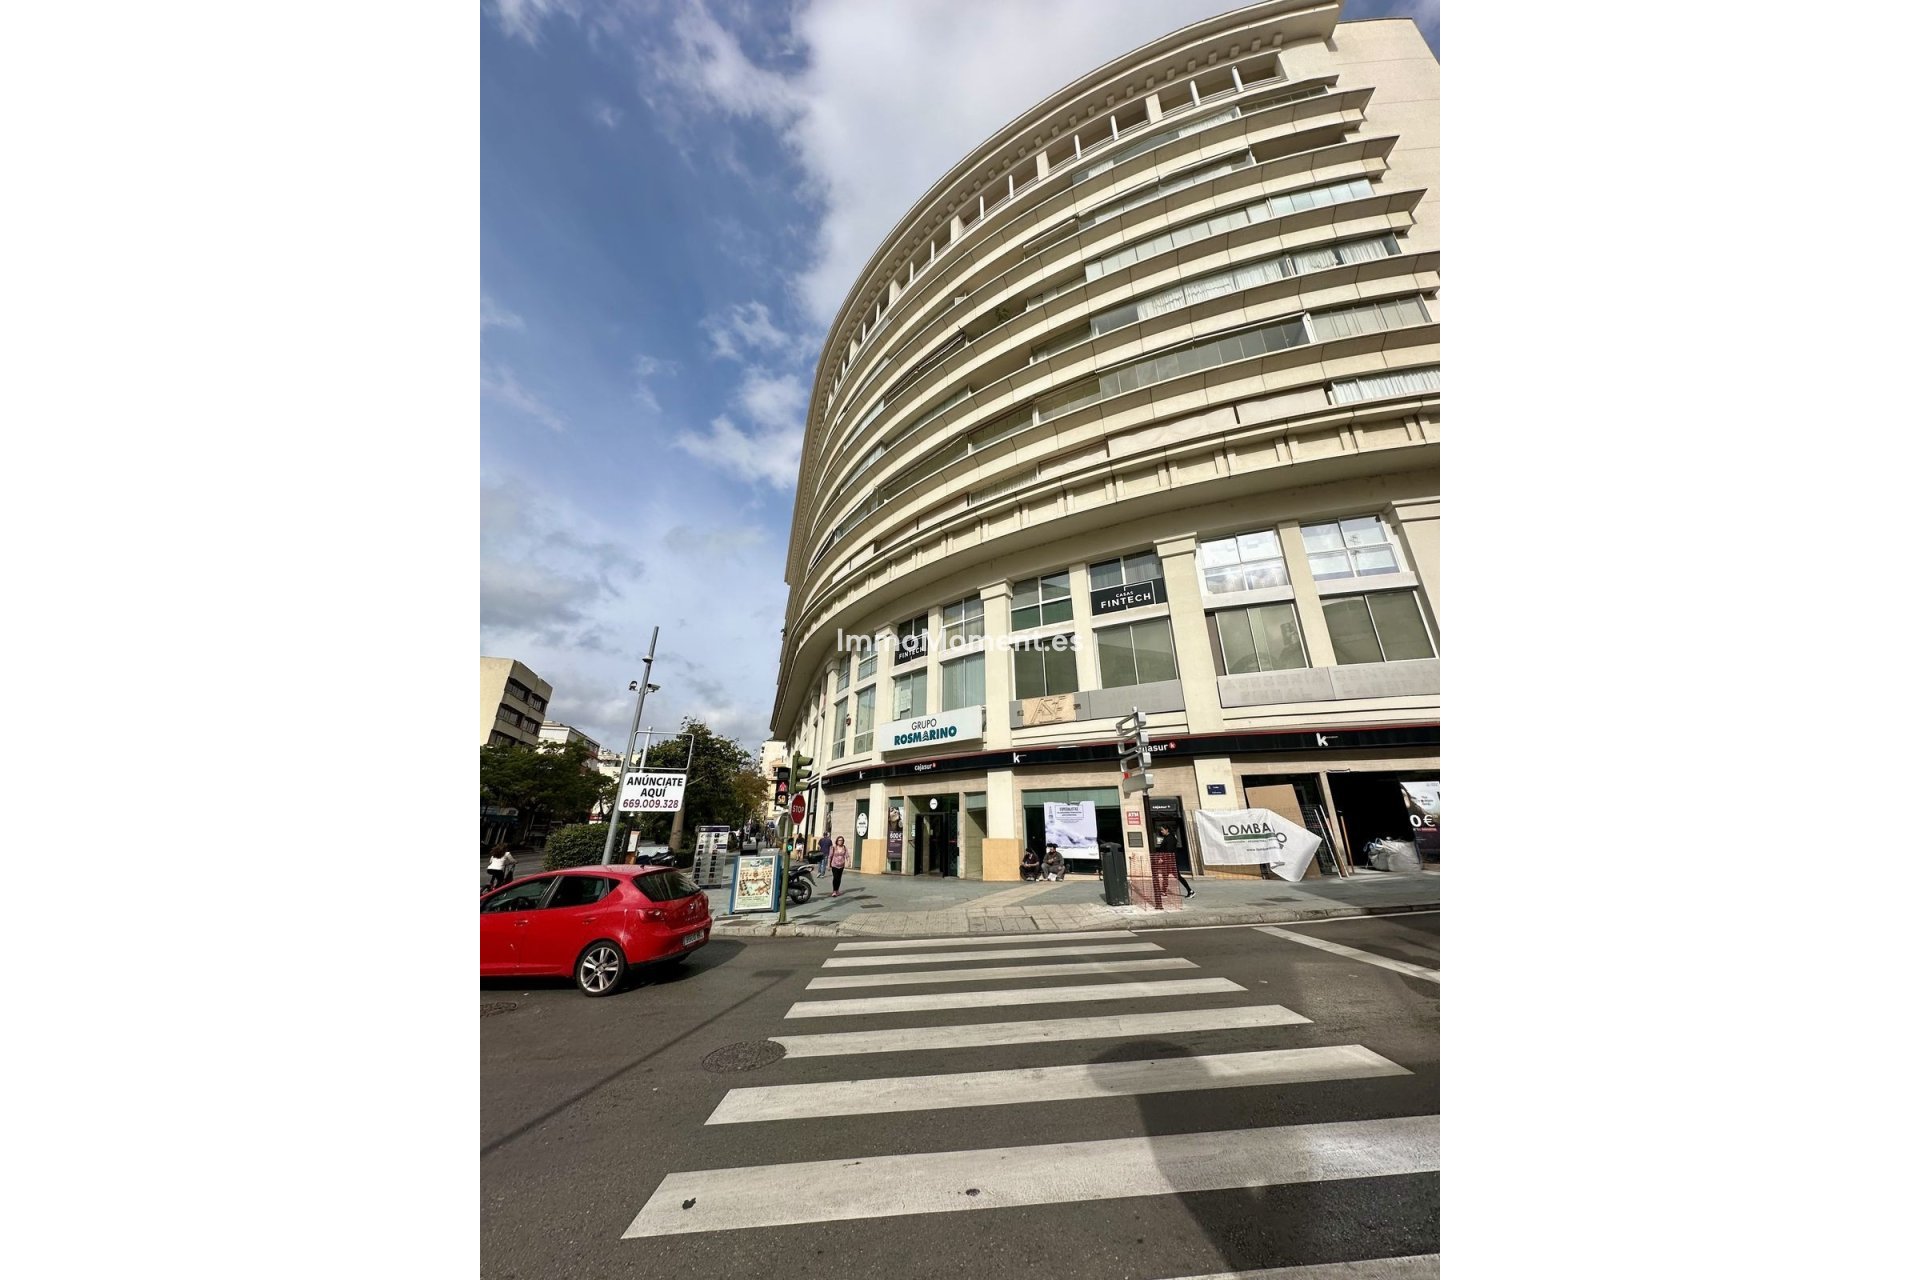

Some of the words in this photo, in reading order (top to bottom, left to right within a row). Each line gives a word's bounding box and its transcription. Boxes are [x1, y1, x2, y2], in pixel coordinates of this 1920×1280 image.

[1115, 590, 1134, 598] CASAS
[1100, 592, 1151, 609] FINTECH
[911, 718, 937, 731] GRUPO
[894, 725, 957, 746] ROSMARINO
[914, 764, 933, 772] cajasur
[626, 774, 684, 787] ANÚNCIATE
[640, 786, 667, 798] AQUÍ
[622, 798, 679, 809] 669.009.328
[792, 805, 804, 814] STOP
[1221, 822, 1274, 836] LOMBA
